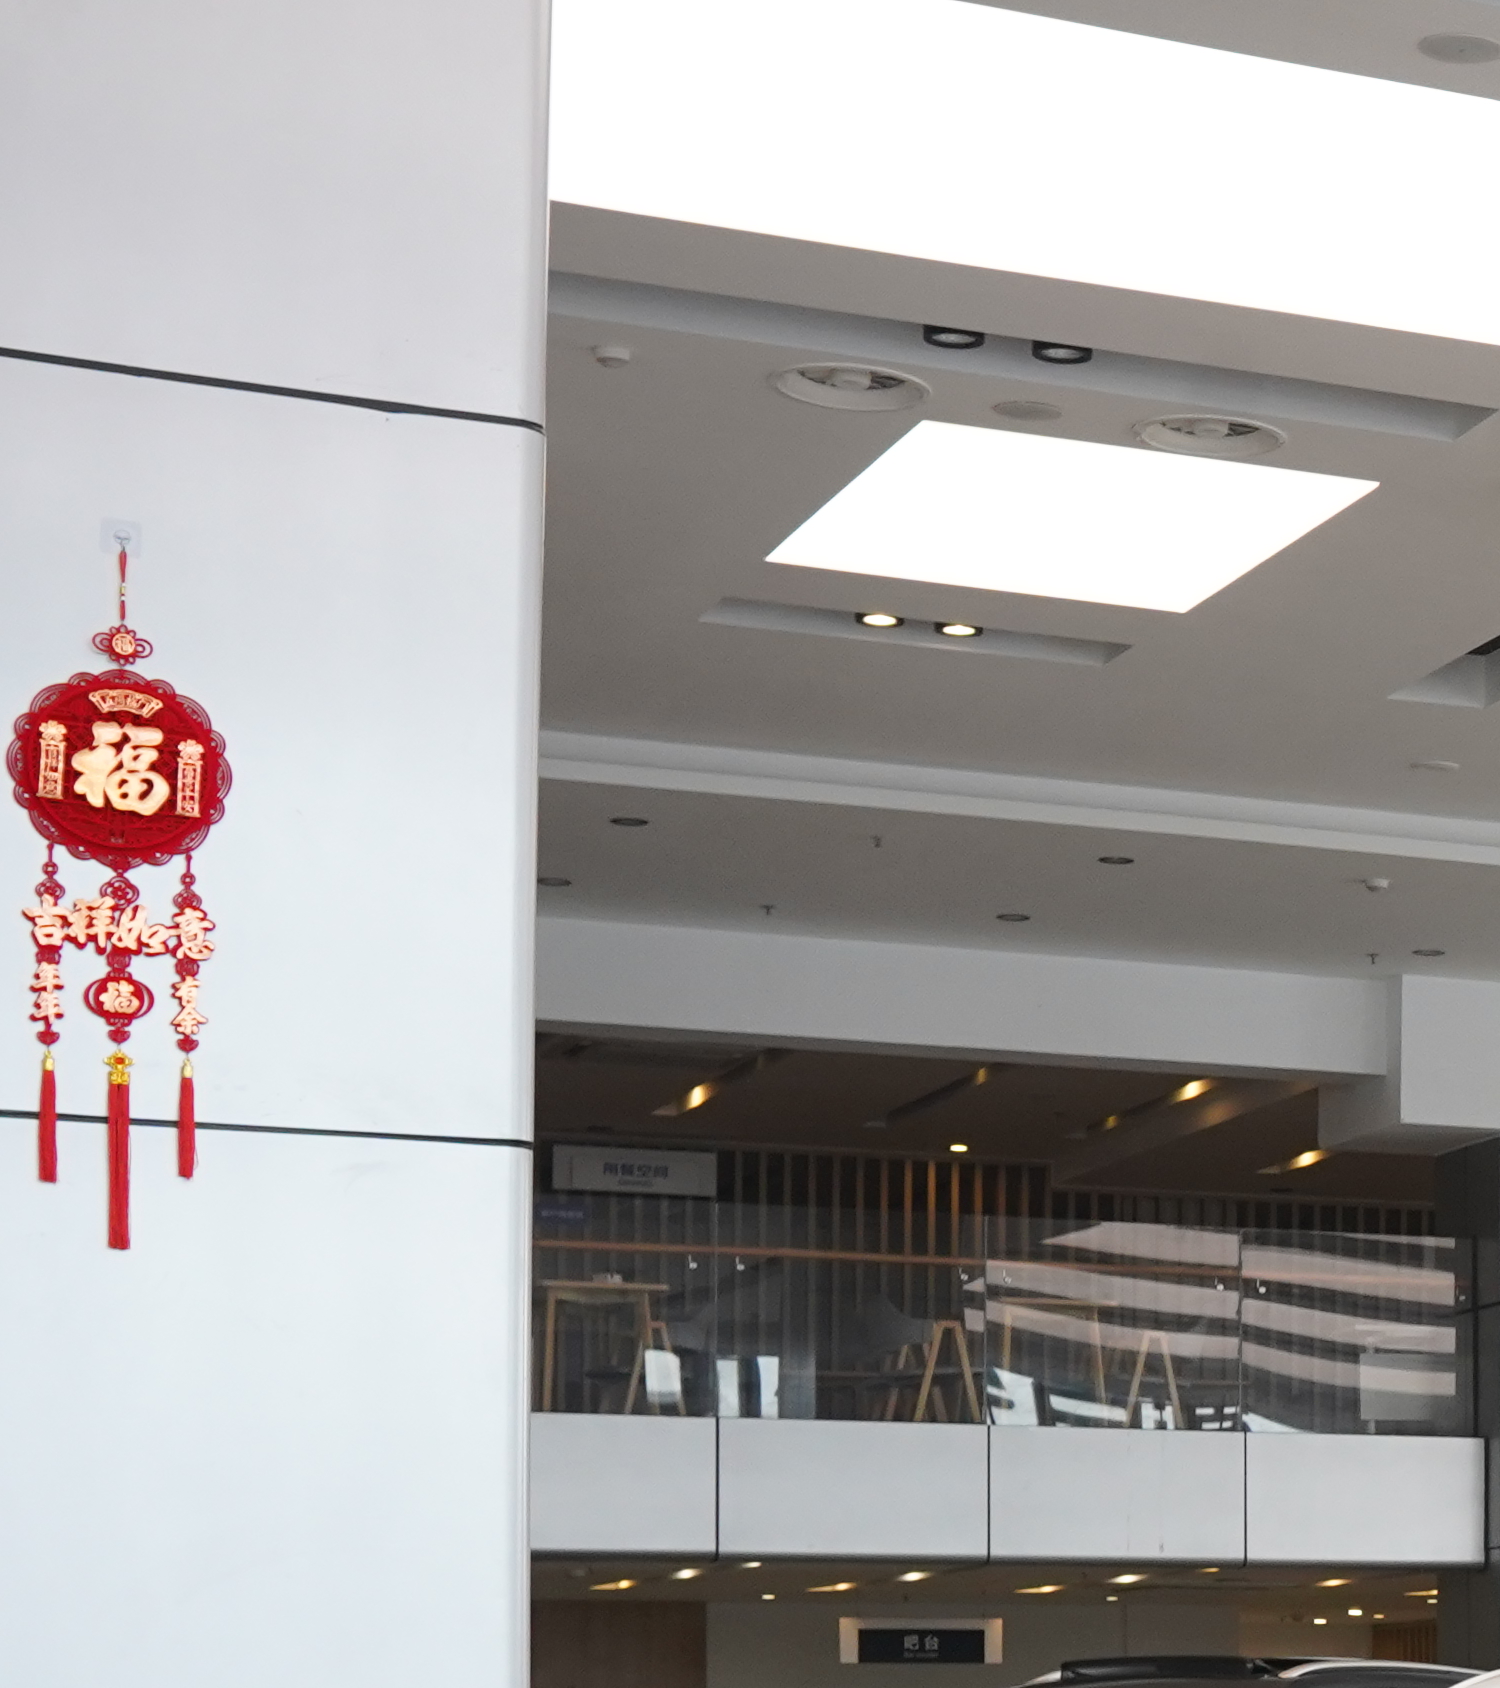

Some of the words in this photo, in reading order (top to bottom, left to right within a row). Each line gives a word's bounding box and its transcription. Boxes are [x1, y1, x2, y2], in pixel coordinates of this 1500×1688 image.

[71, 721, 170, 816] 福
[22, 893, 214, 960] 吉祥如意
[99, 980, 140, 1014] 福
[172, 976, 208, 1035] 有余
